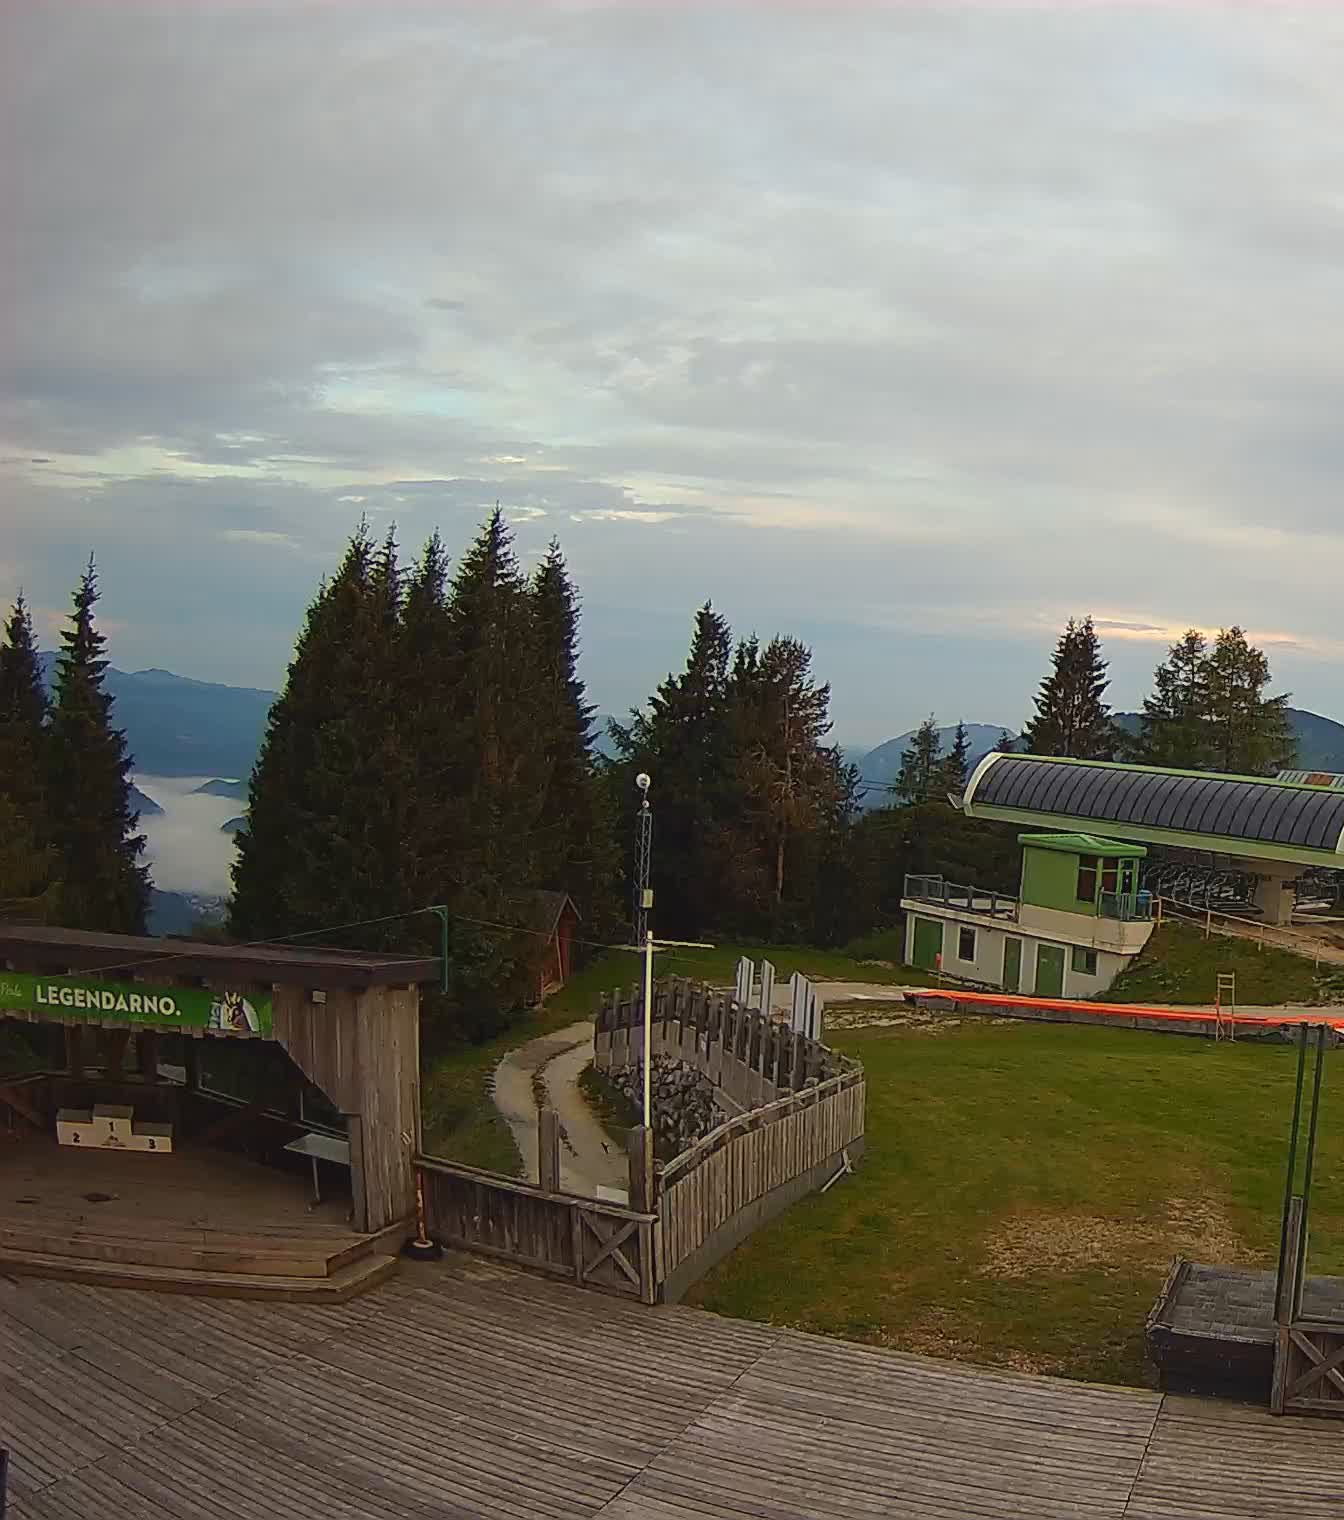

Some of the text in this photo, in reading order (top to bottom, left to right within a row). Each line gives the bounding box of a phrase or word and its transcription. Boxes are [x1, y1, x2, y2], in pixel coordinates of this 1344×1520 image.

[36, 984, 182, 1017] LEGENDARNO.
[108, 1121, 115, 1133] 1
[72, 1131, 81, 1144] 2
[147, 1138, 156, 1150] 3
